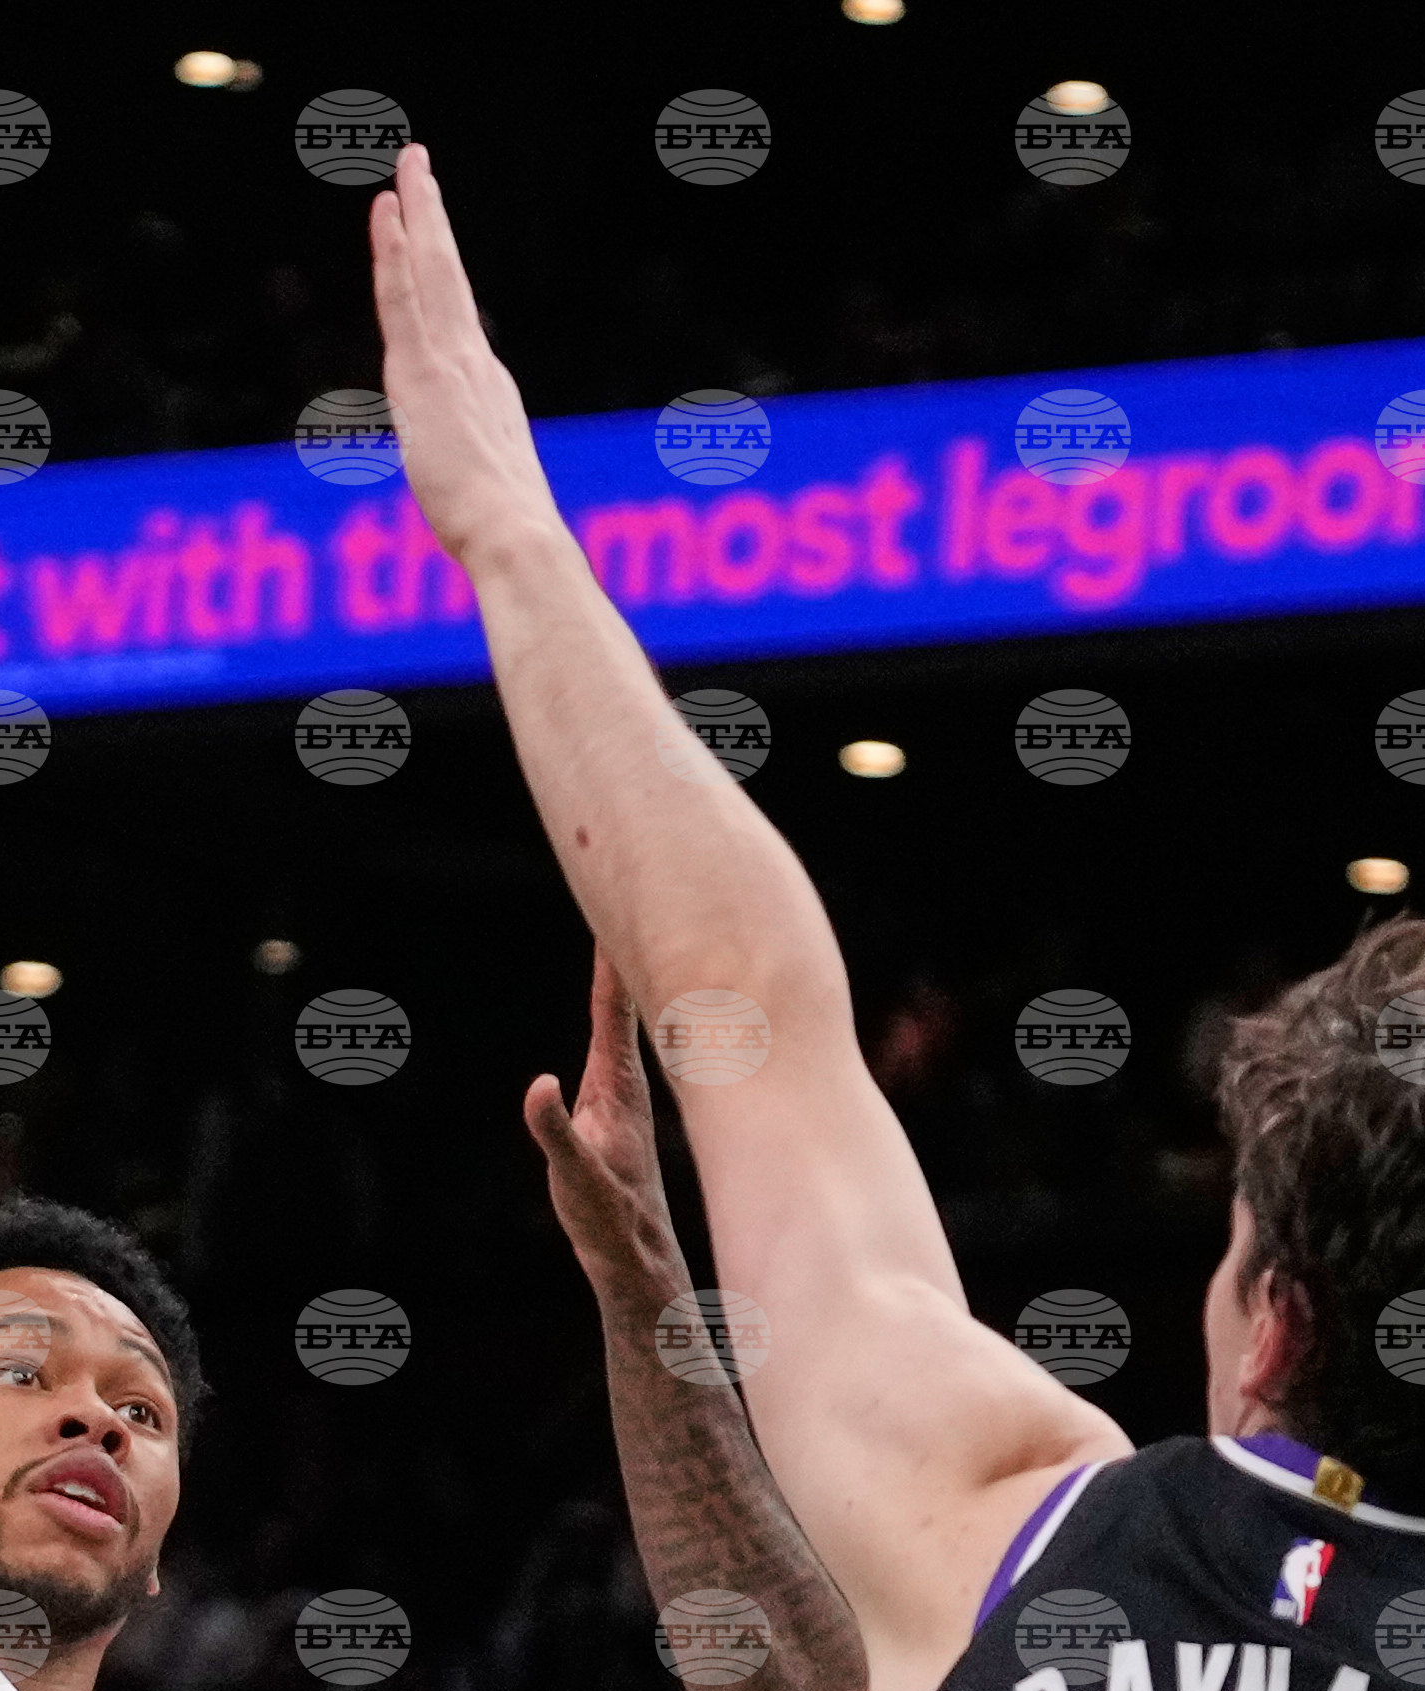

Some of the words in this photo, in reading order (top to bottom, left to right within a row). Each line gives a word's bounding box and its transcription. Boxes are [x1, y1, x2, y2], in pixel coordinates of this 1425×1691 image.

[30, 502, 309, 650] with
[333, 486, 475, 632] th
[583, 453, 923, 607] most
